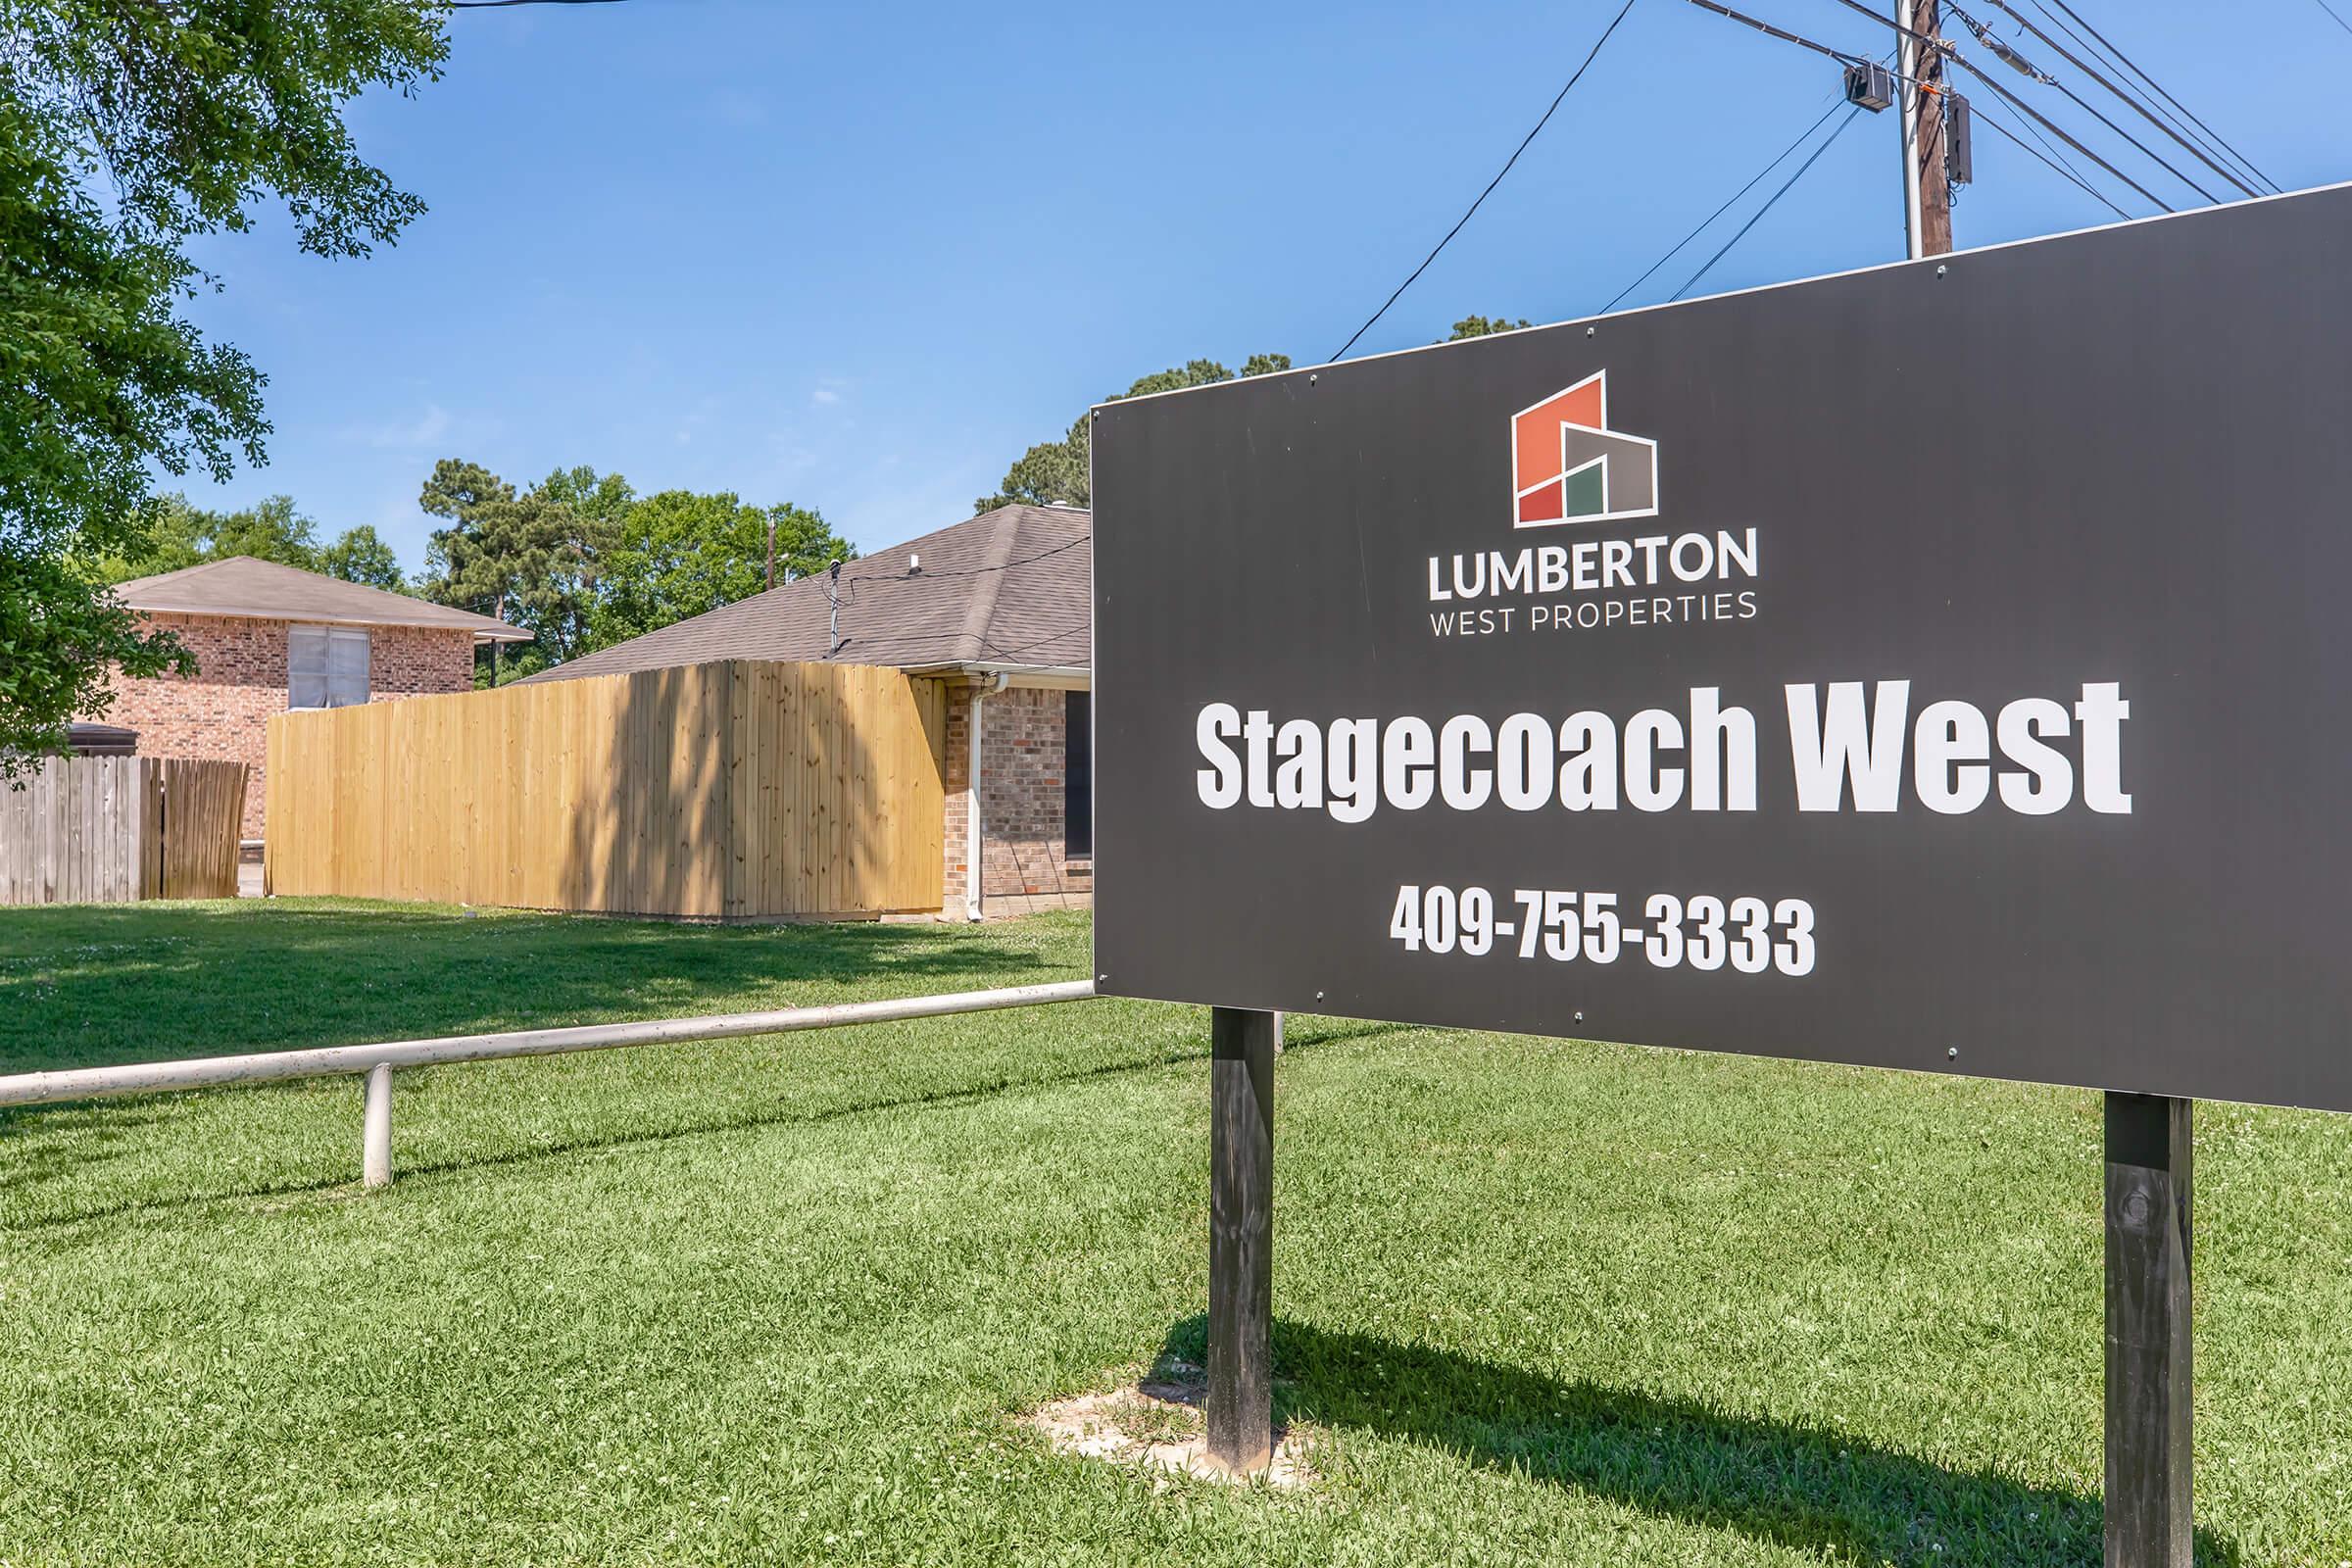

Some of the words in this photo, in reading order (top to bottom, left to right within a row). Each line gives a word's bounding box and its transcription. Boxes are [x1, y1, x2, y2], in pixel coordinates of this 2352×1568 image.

[1428, 526, 1759, 602] LUMBERTON
[1430, 607, 1516, 637] WEST
[1531, 591, 1758, 632] PROPERTIES
[1196, 686, 1757, 824] Stagecoach
[1784, 679, 2132, 815] West
[1390, 885, 1816, 977] 409-755-3333
